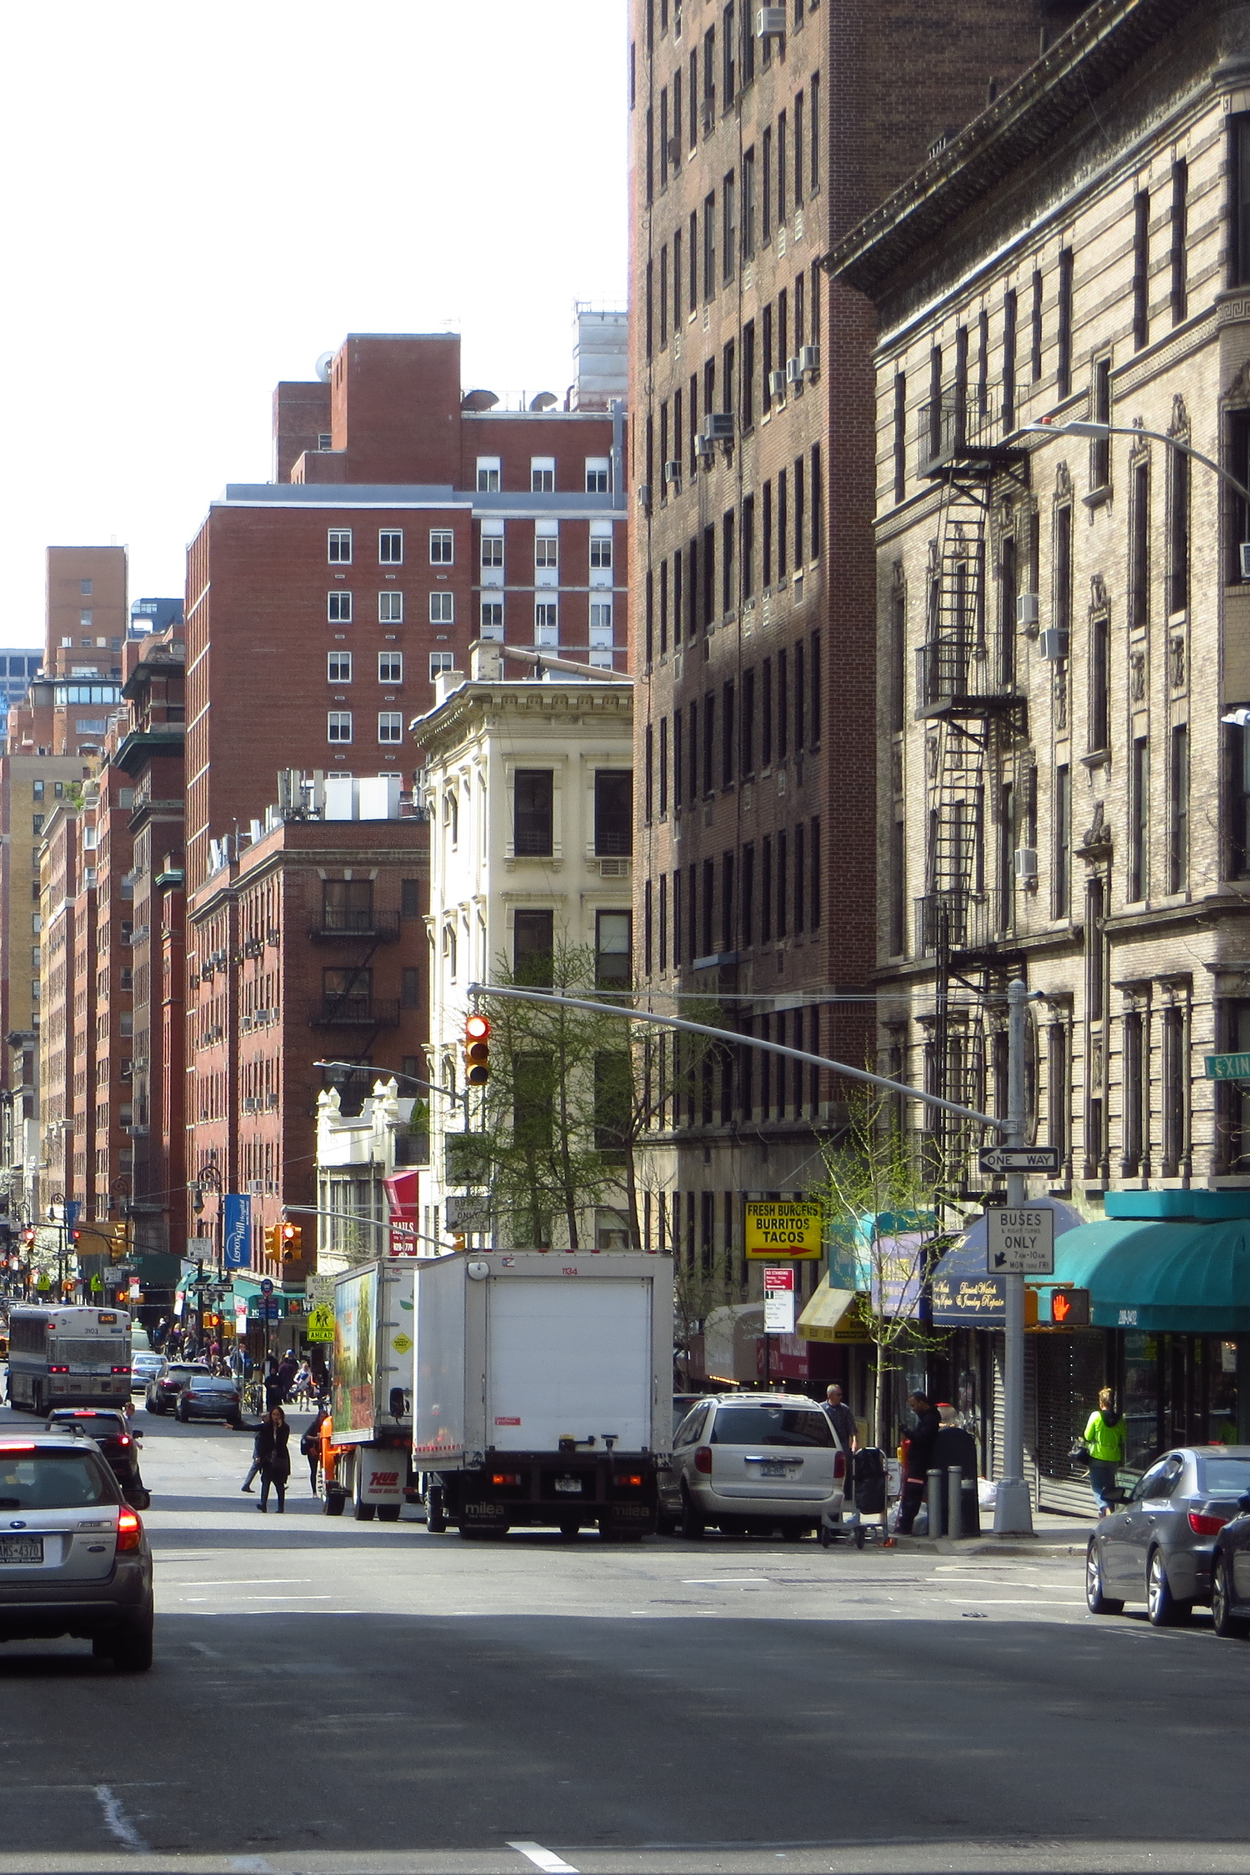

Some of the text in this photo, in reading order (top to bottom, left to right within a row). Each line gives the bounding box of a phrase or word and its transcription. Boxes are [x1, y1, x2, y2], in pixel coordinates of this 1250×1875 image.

[1207, 1056, 1250, 1077] LEXIN
[987, 1155, 1051, 1165] ONE WAY
[748, 1205, 776, 1217] FRESH
[756, 1218, 810, 1231] BURRITOS
[1000, 1213, 1041, 1226] BUSES
[236, 1221, 245, 1239] Hill
[762, 1231, 804, 1243] TACOS
[1004, 1236, 1037, 1249] ONLY
[233, 1237, 241, 1263] Lenox
[562, 1267, 578, 1275] 1134
[1038, 1261, 1049, 1269] FRI
[310, 1331, 333, 1339] AHEAD
[370, 1472, 399, 1486] HUB
[464, 1502, 505, 1515] milea
[612, 1504, 650, 1517] milea
